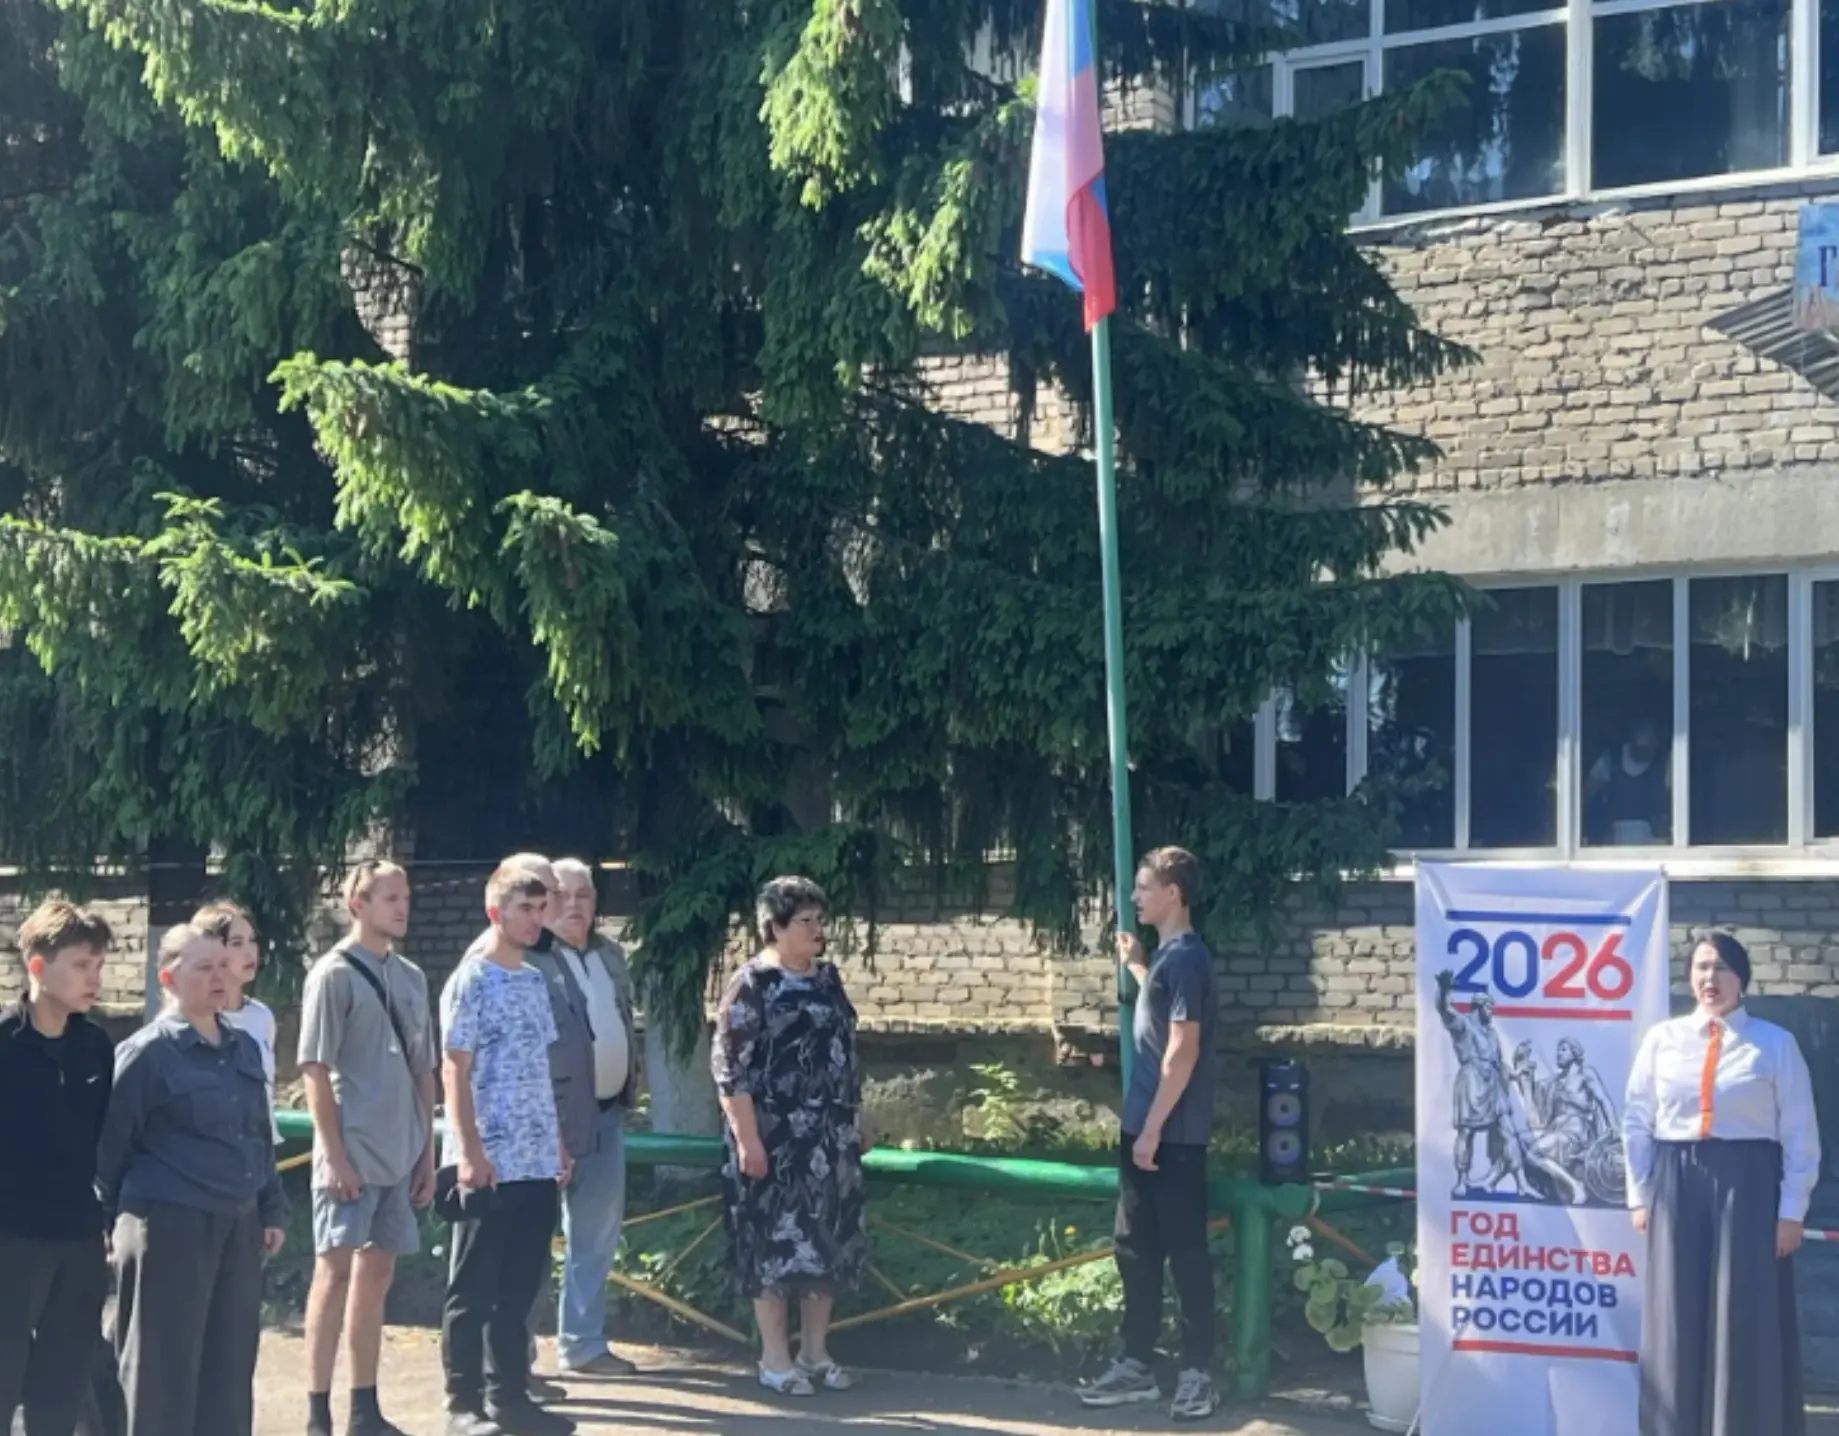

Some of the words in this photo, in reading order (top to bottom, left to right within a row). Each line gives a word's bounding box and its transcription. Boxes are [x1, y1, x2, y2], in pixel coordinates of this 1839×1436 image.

[1447, 928, 1634, 1001] 2026
[1451, 1210, 1520, 1241] ГОД
[1451, 1243, 1636, 1277] ЕДИНСТВА
[1452, 1274, 1618, 1308] НАРОДОВ
[1452, 1306, 1598, 1338] РОССИИ
